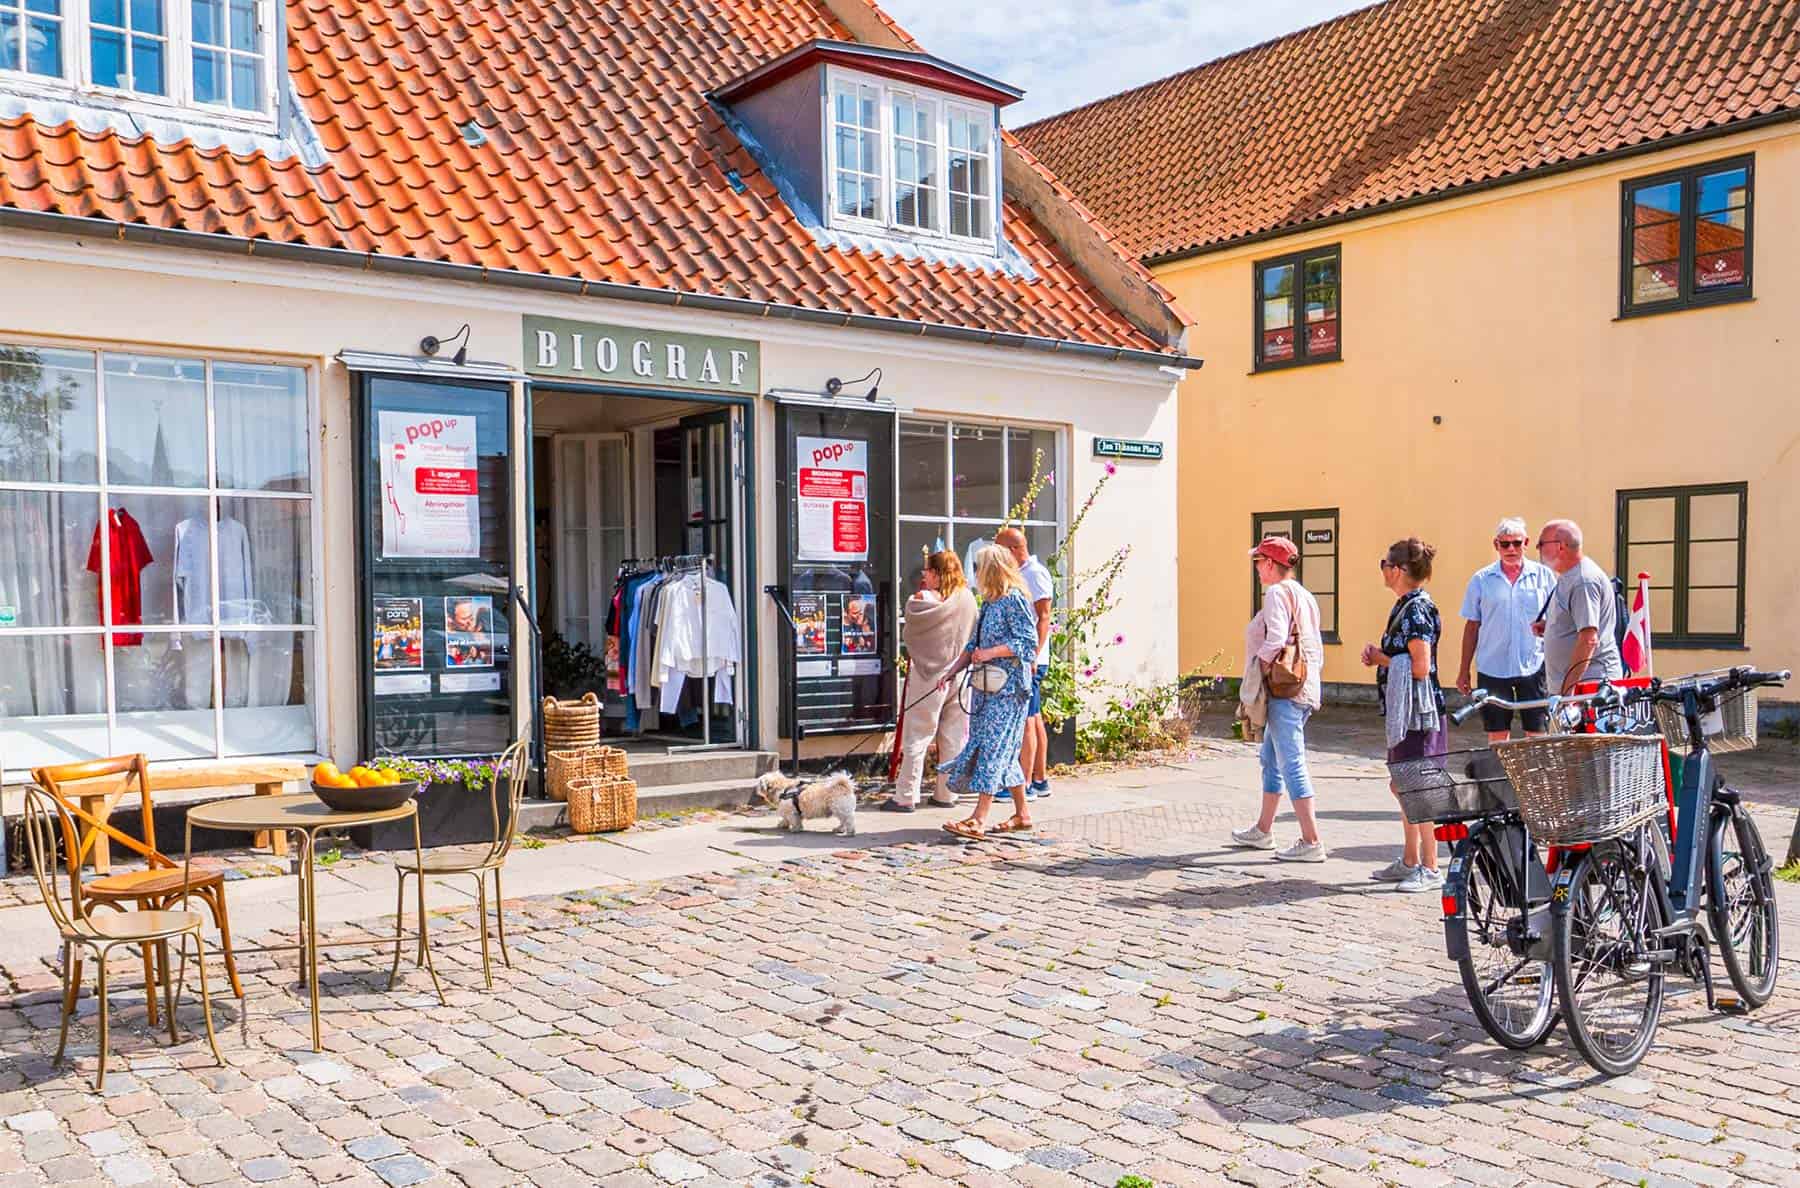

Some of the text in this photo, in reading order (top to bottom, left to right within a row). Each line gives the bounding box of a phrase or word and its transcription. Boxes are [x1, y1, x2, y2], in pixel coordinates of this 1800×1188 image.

[536, 330, 749, 385] BIOGRAF
[405, 418, 457, 445] pop up
[812, 442, 854, 467] pop up
[1307, 531, 1330, 541] Normal
